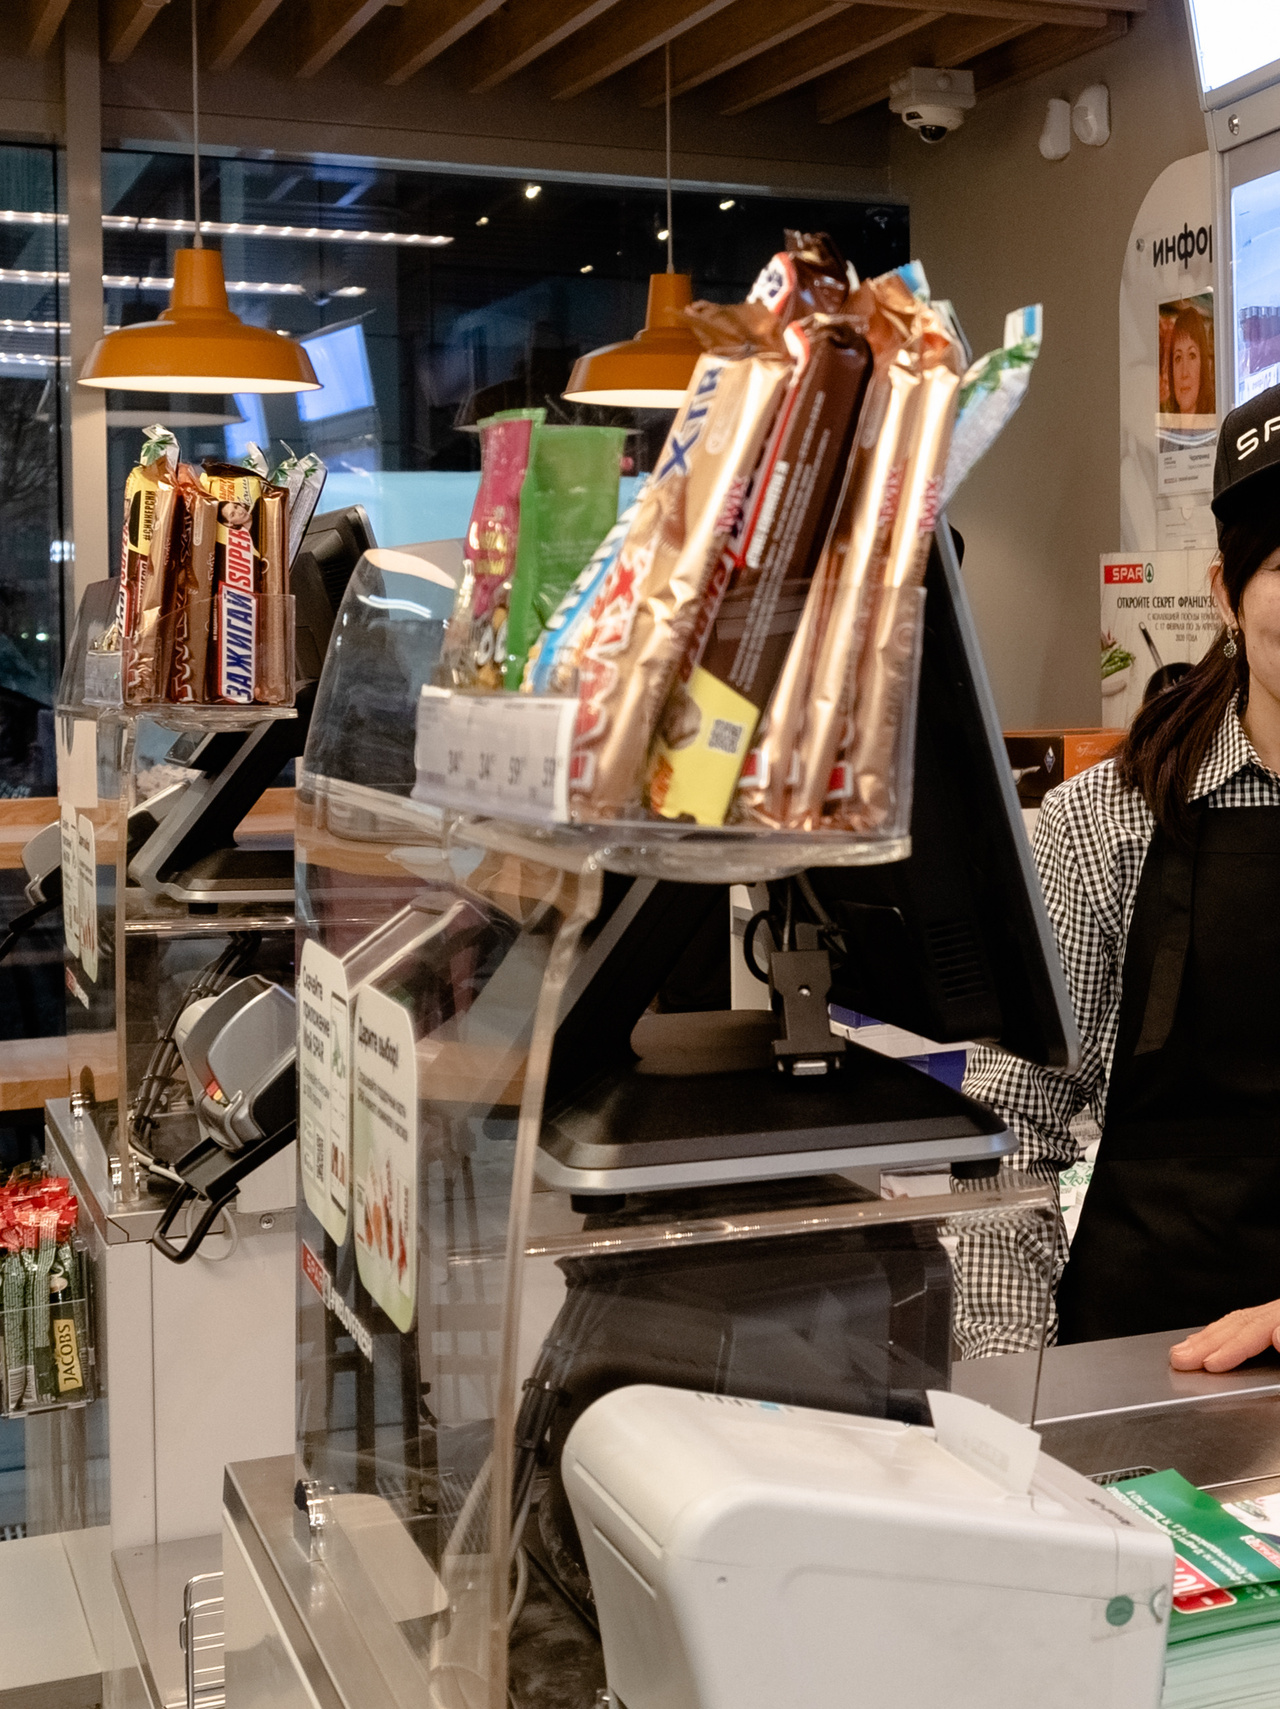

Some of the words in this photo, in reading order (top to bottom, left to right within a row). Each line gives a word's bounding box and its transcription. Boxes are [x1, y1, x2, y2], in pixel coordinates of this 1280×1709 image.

[228, 528, 252, 587] SUPER
[1112, 566, 1143, 581] SPAR
[1116, 596, 1150, 609] ОТКРОЙТЕ
[1152, 596, 1175, 608] СЕКРЕТ
[223, 590, 254, 701] ЗАЖИГАЙ
[58, 1323, 79, 1385] JACOBS
